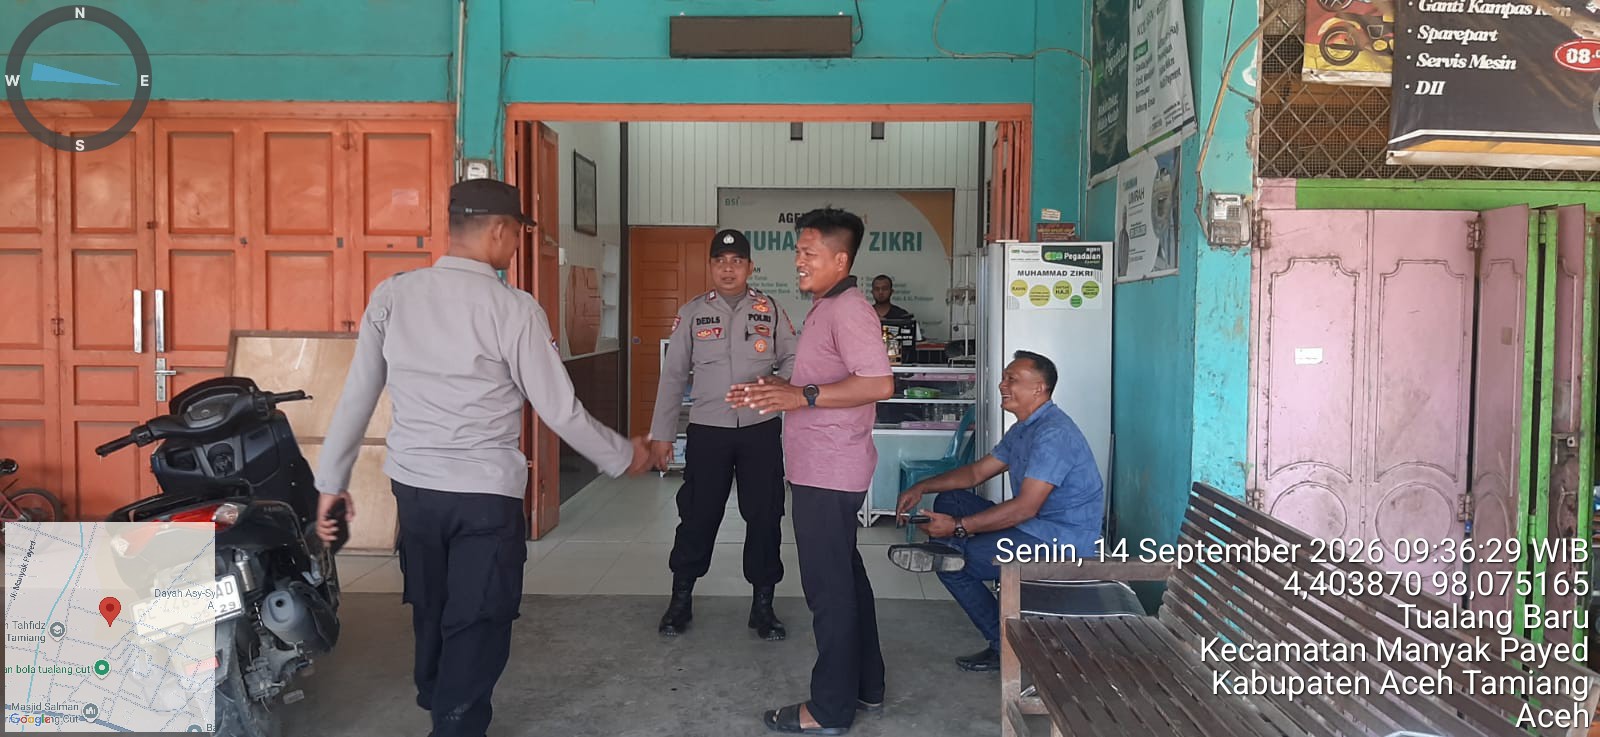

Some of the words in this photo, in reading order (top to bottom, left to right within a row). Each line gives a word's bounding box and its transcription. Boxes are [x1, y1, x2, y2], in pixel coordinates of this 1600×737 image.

[1418, 0, 1464, 14] Ganti
[1467, 0, 1533, 19] Kampas
[1417, 24, 1499, 45] Sparepart
[1416, 53, 1468, 70] Servis
[1468, 54, 1518, 71] Mesin
[868, 231, 922, 252] ZIKRI
